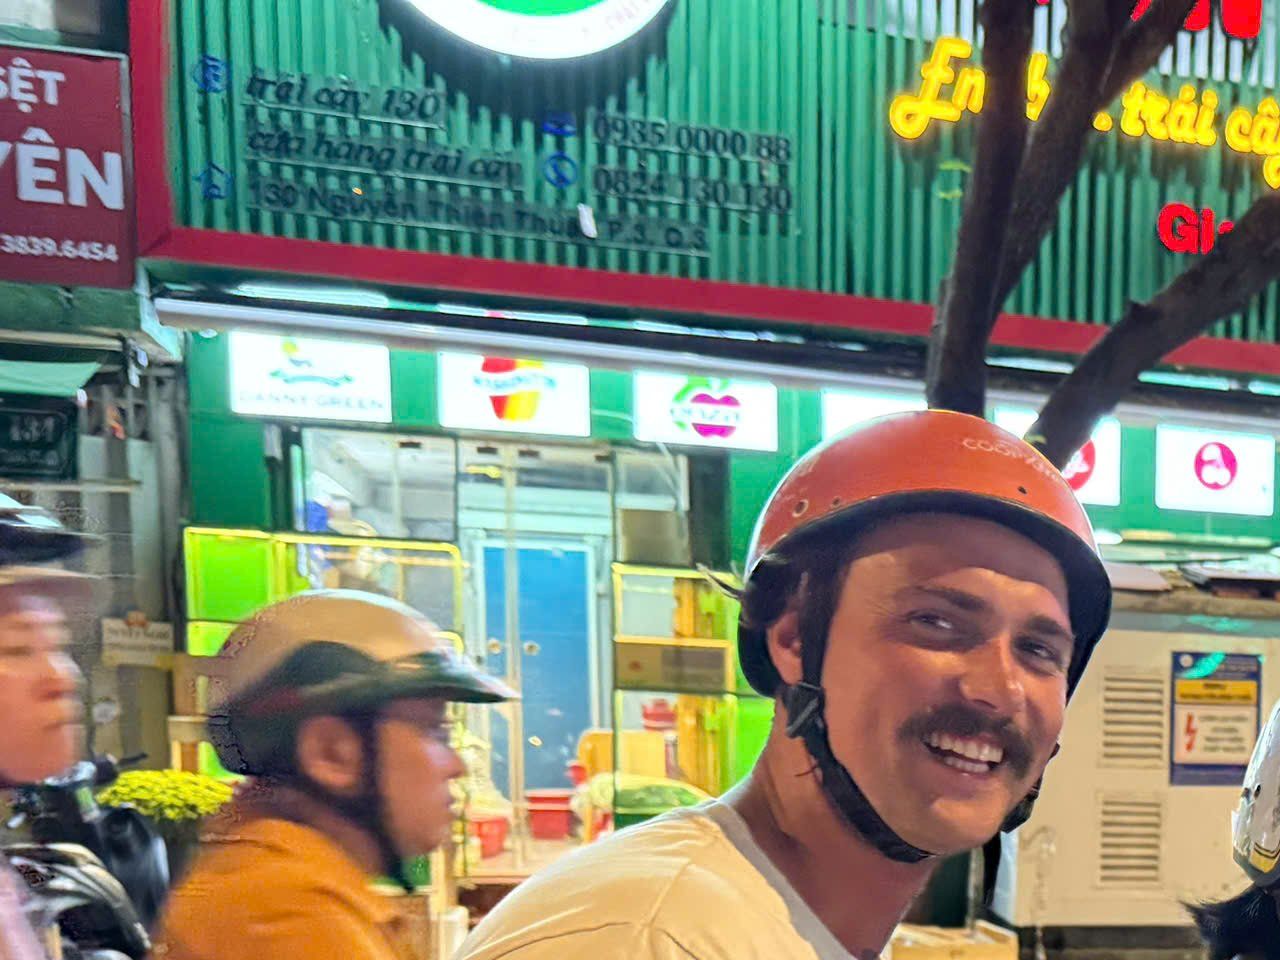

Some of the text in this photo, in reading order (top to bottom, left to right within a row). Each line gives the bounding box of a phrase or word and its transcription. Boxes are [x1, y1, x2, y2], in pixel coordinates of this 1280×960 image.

[383, 88, 440, 120] 130
[1120, 81, 1218, 146] trái
[594, 117, 791, 163] 0935 0000 88
[0, 127, 125, 211] ÊN
